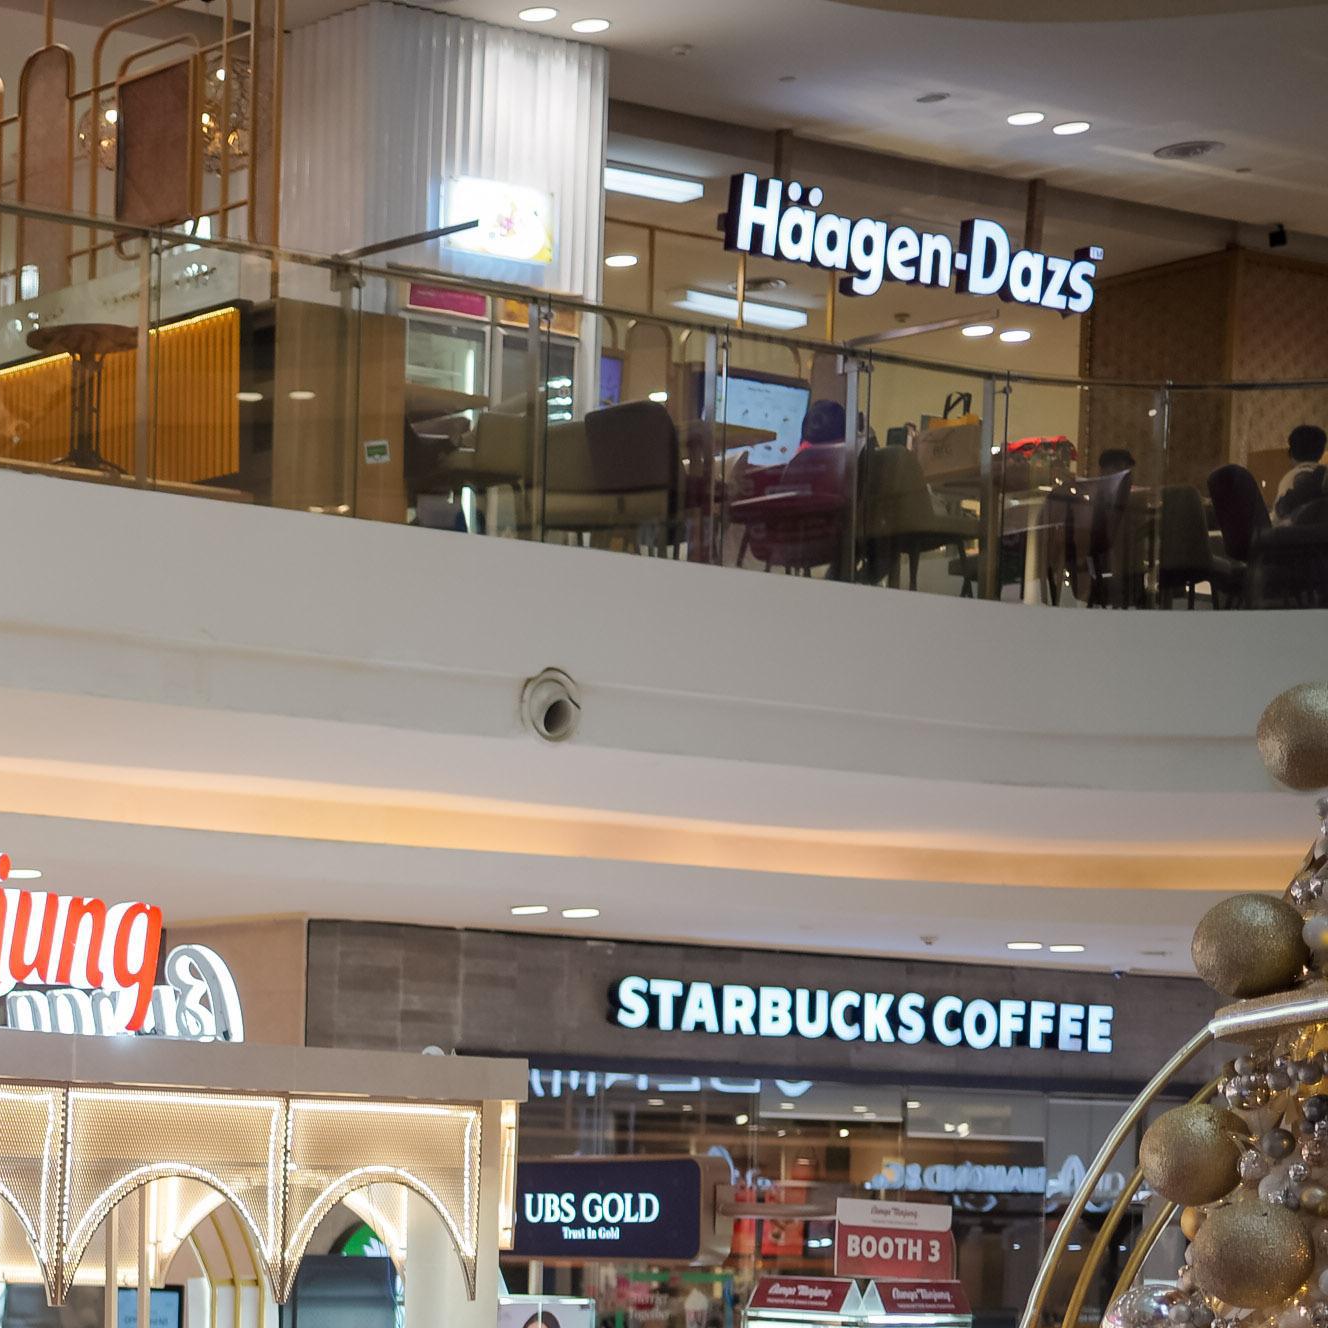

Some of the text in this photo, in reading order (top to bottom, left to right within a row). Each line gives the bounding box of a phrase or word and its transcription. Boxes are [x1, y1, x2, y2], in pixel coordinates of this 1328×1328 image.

[736, 172, 1097, 314] Häagen-Dazs
[616, 976, 1114, 1053] STARBUCKS COFFEE
[523, 1192, 660, 1223] UBS GOLD
[846, 1234, 941, 1263] BOOTH 3
